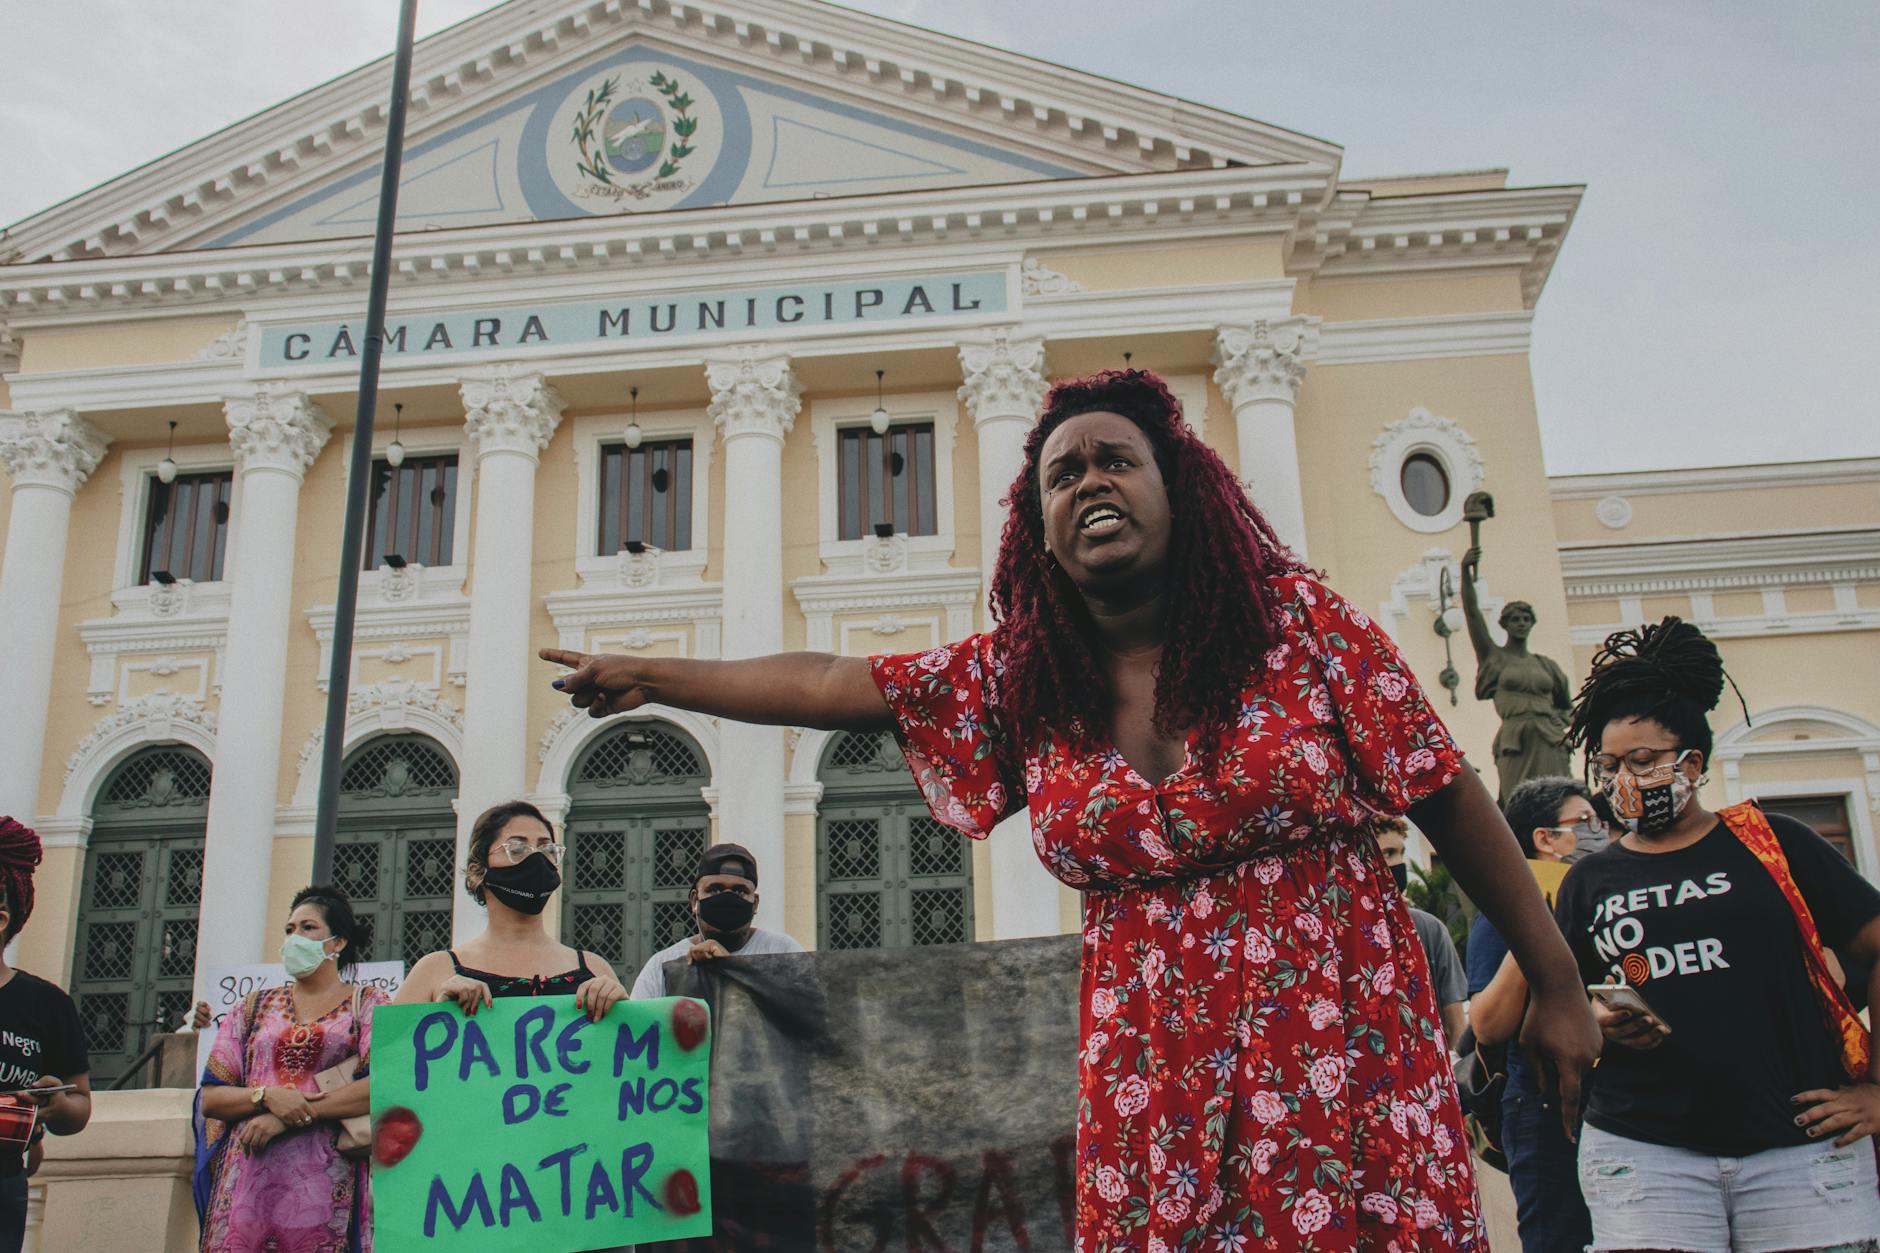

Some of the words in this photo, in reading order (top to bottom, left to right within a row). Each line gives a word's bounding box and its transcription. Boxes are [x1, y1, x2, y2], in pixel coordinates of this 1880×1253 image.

[284, 315, 549, 361] CÂMARA
[597, 283, 981, 337] MUNICIPAL
[1594, 917, 1644, 962] NO
[413, 1005, 660, 1091] PAREM
[502, 1083, 573, 1125] DE
[618, 1077, 704, 1121] NOS
[423, 1142, 666, 1238] MATAR
